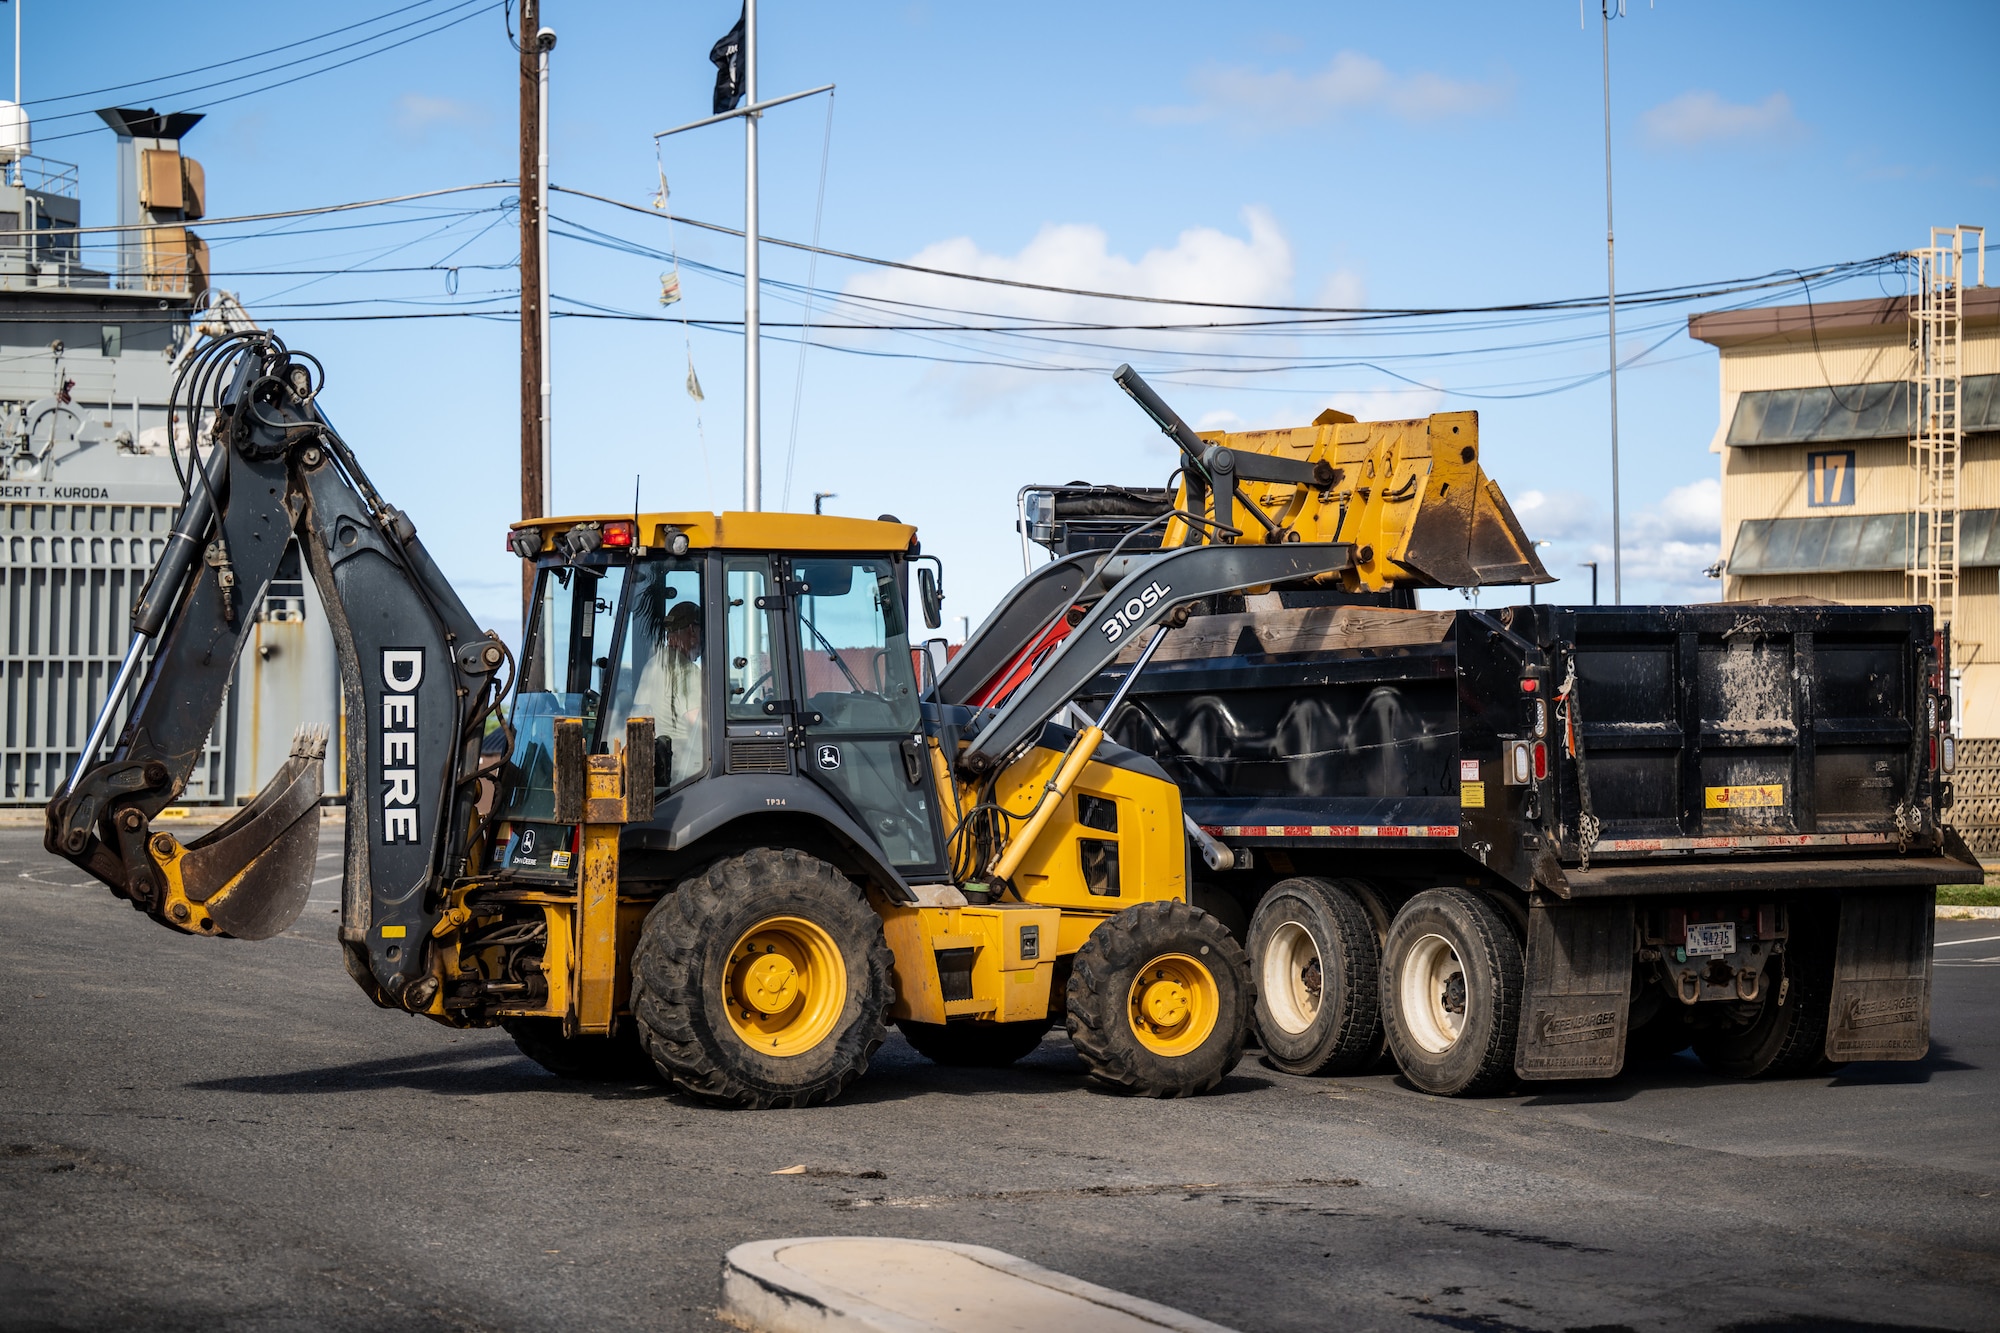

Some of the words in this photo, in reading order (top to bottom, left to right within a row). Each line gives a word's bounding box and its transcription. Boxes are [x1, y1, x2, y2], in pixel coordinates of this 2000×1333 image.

[38, 486, 49, 498] T.
[54, 487, 109, 499] KURODA
[1814, 454, 1847, 504] 17
[1101, 581, 1172, 643] 310SL
[383, 650, 423, 842] DEERE
[1703, 931, 1729, 946] 54275
[1528, 1009, 1616, 1046] KAFFENBARGER
